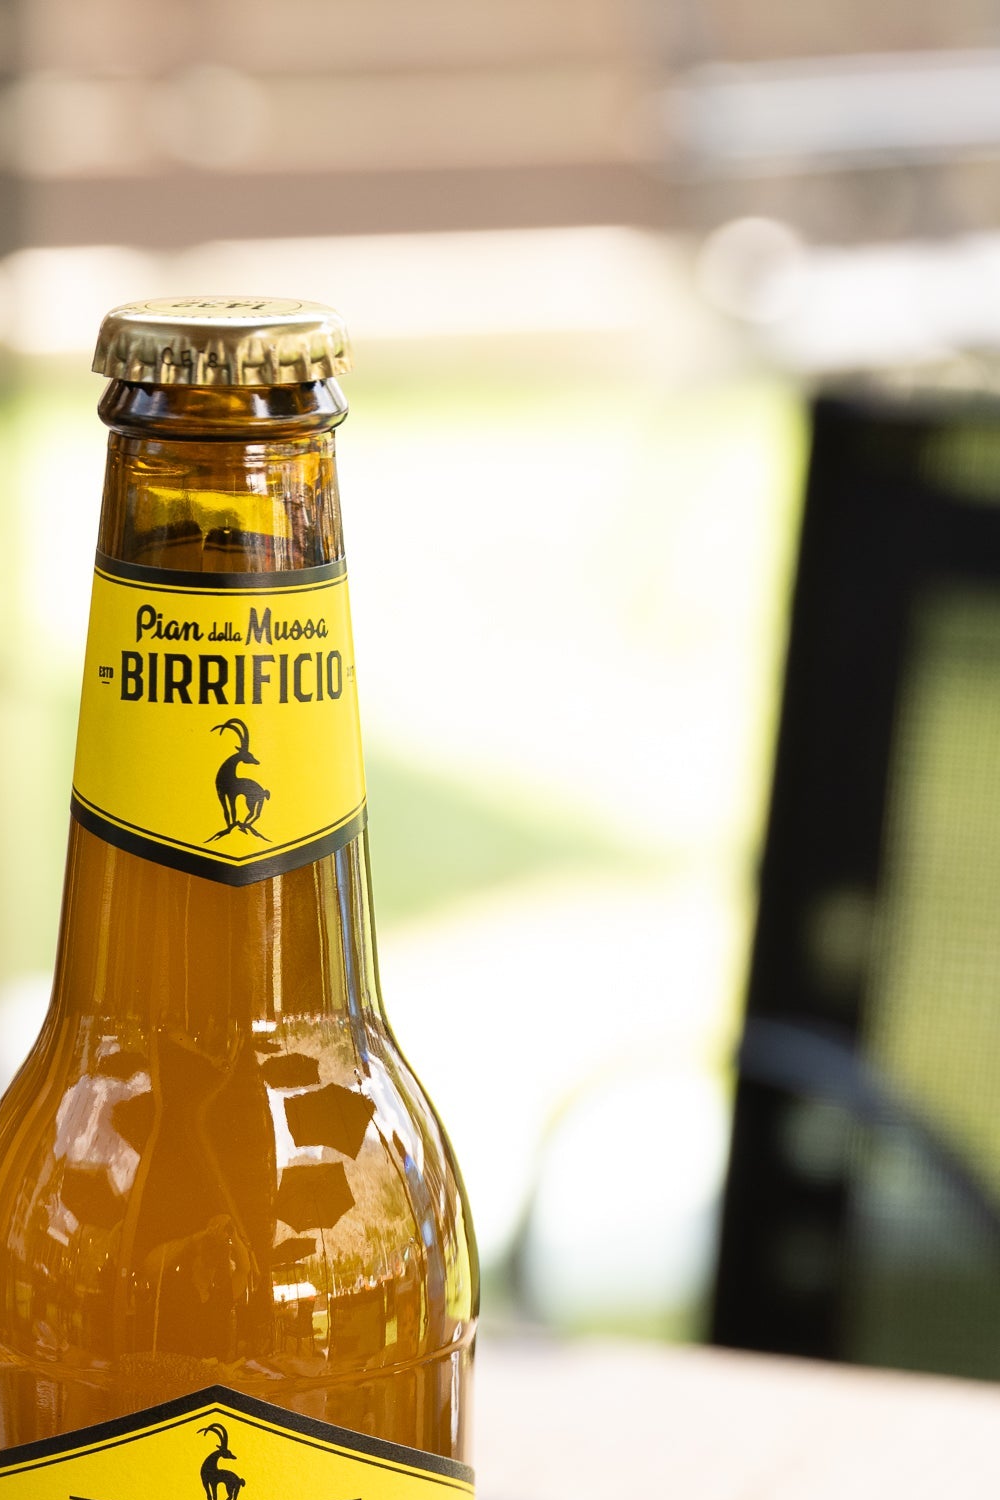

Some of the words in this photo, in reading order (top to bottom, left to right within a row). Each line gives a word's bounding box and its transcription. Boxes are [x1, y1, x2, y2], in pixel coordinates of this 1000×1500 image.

[136, 604, 203, 642] Pian
[208, 621, 242, 642] della
[245, 607, 329, 645] Mussa
[120, 650, 343, 705] BIRRIFICIO
